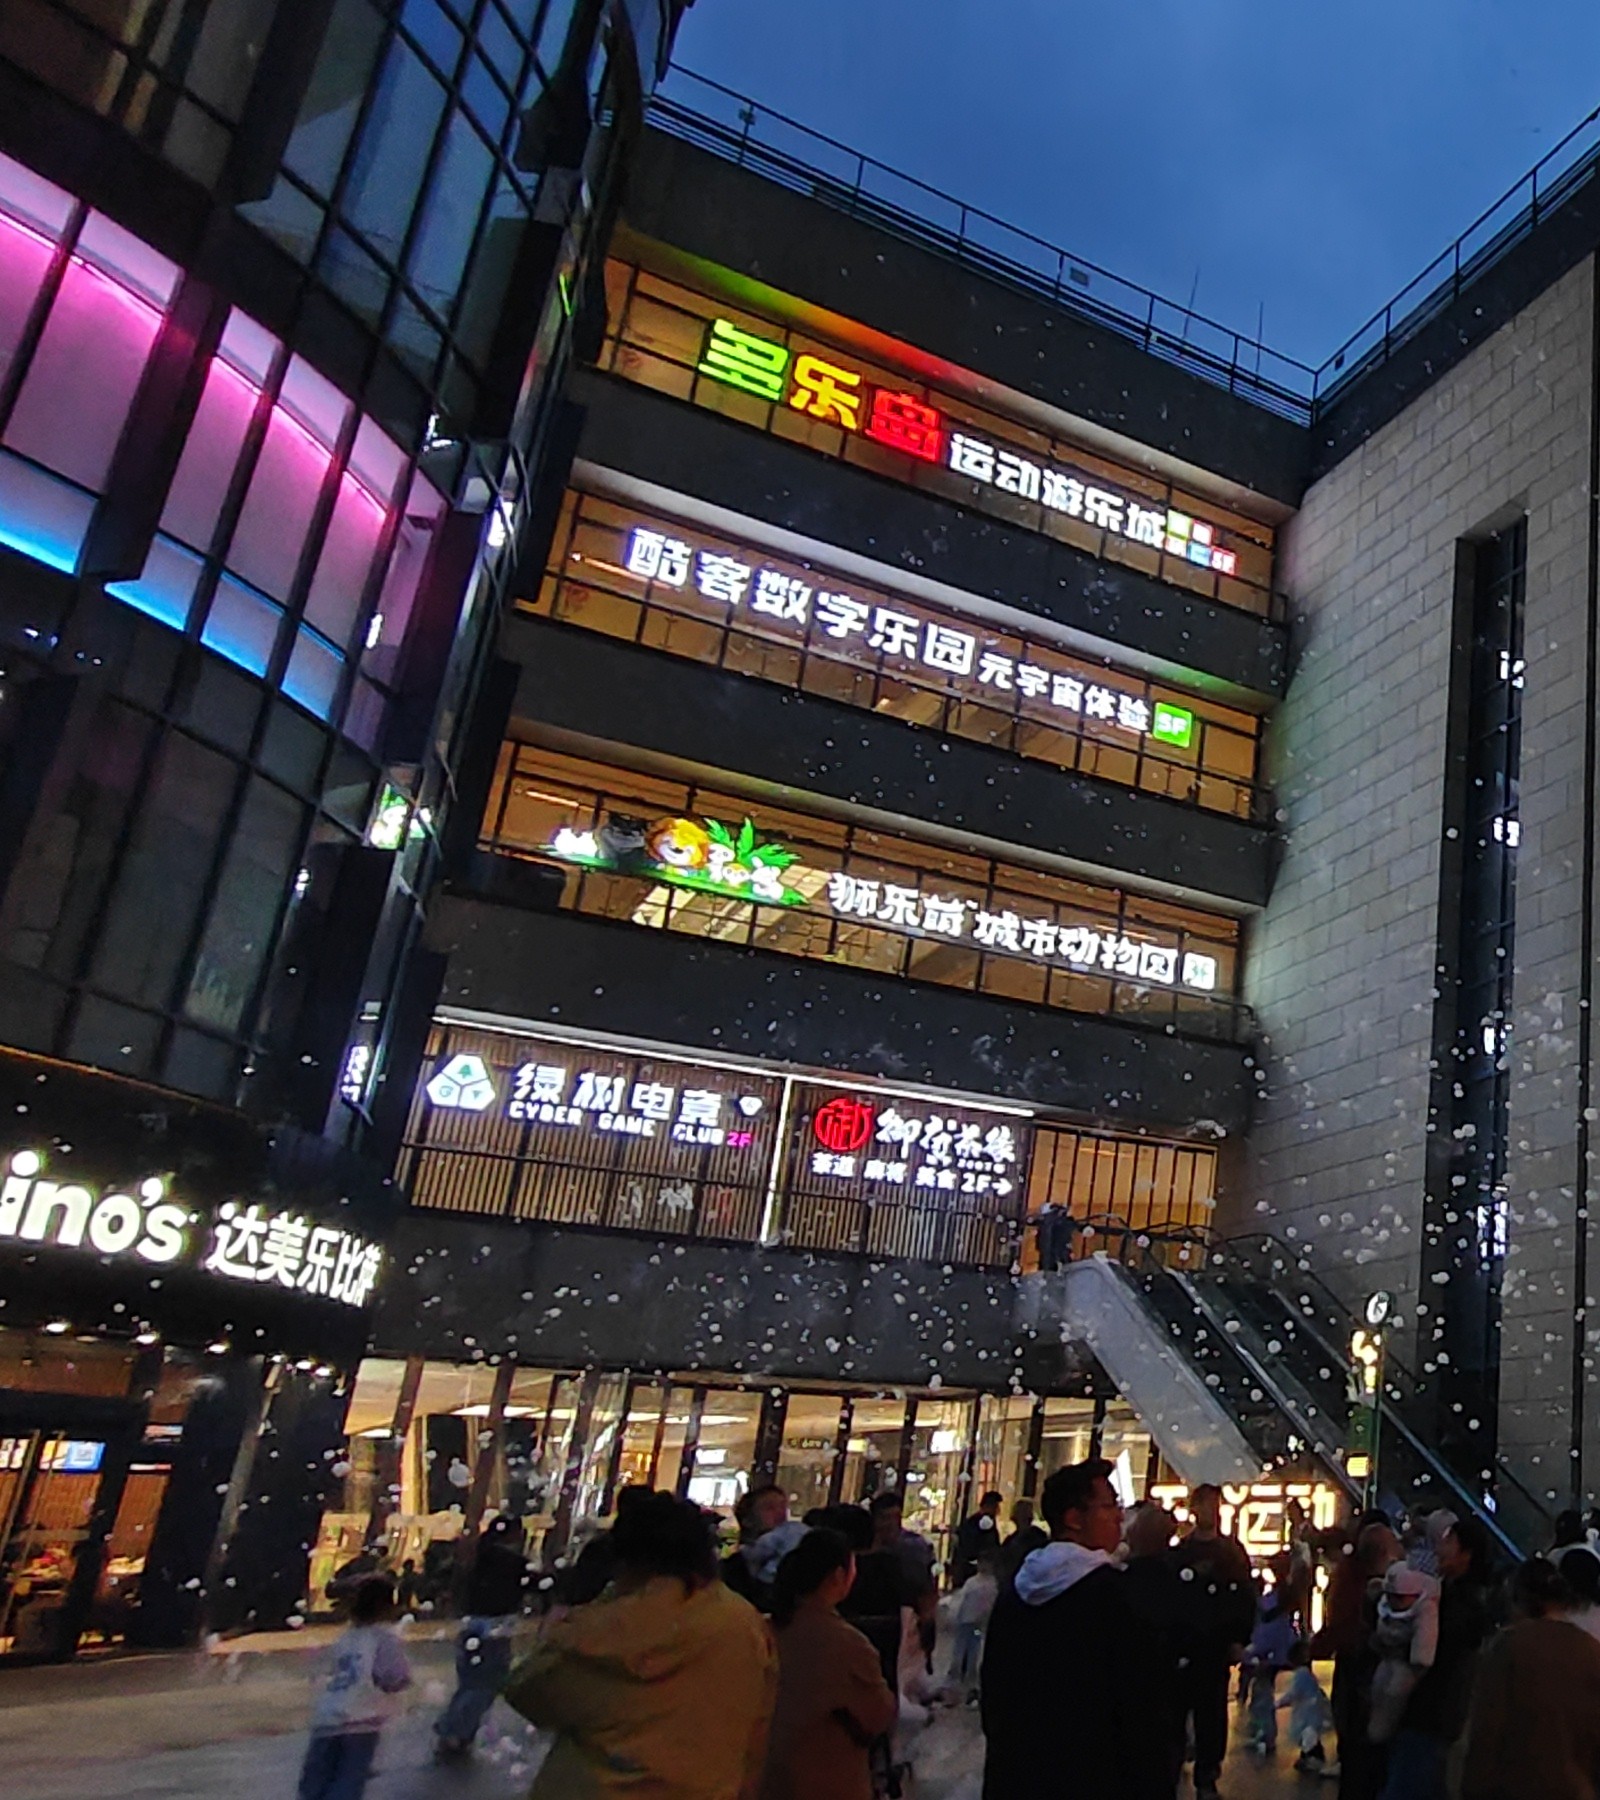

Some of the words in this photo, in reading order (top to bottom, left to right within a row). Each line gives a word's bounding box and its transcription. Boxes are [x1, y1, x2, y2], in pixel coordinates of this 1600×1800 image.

[950, 433, 1166, 549] 运动游乐城
[627, 527, 975, 676] 酷客数字乐园
[978, 652, 1151, 732] 元宇宙体验
[973, 910, 1179, 985] 城市动物园
[508, 1100, 582, 1126] CYBER
[598, 1114, 656, 1137] GAME
[672, 1123, 724, 1145] CLUB
[726, 1132, 753, 1148] 2F
[513, 1062, 722, 1127] 绿树电竞
[205, 1201, 382, 1307] 达美乐比萨
